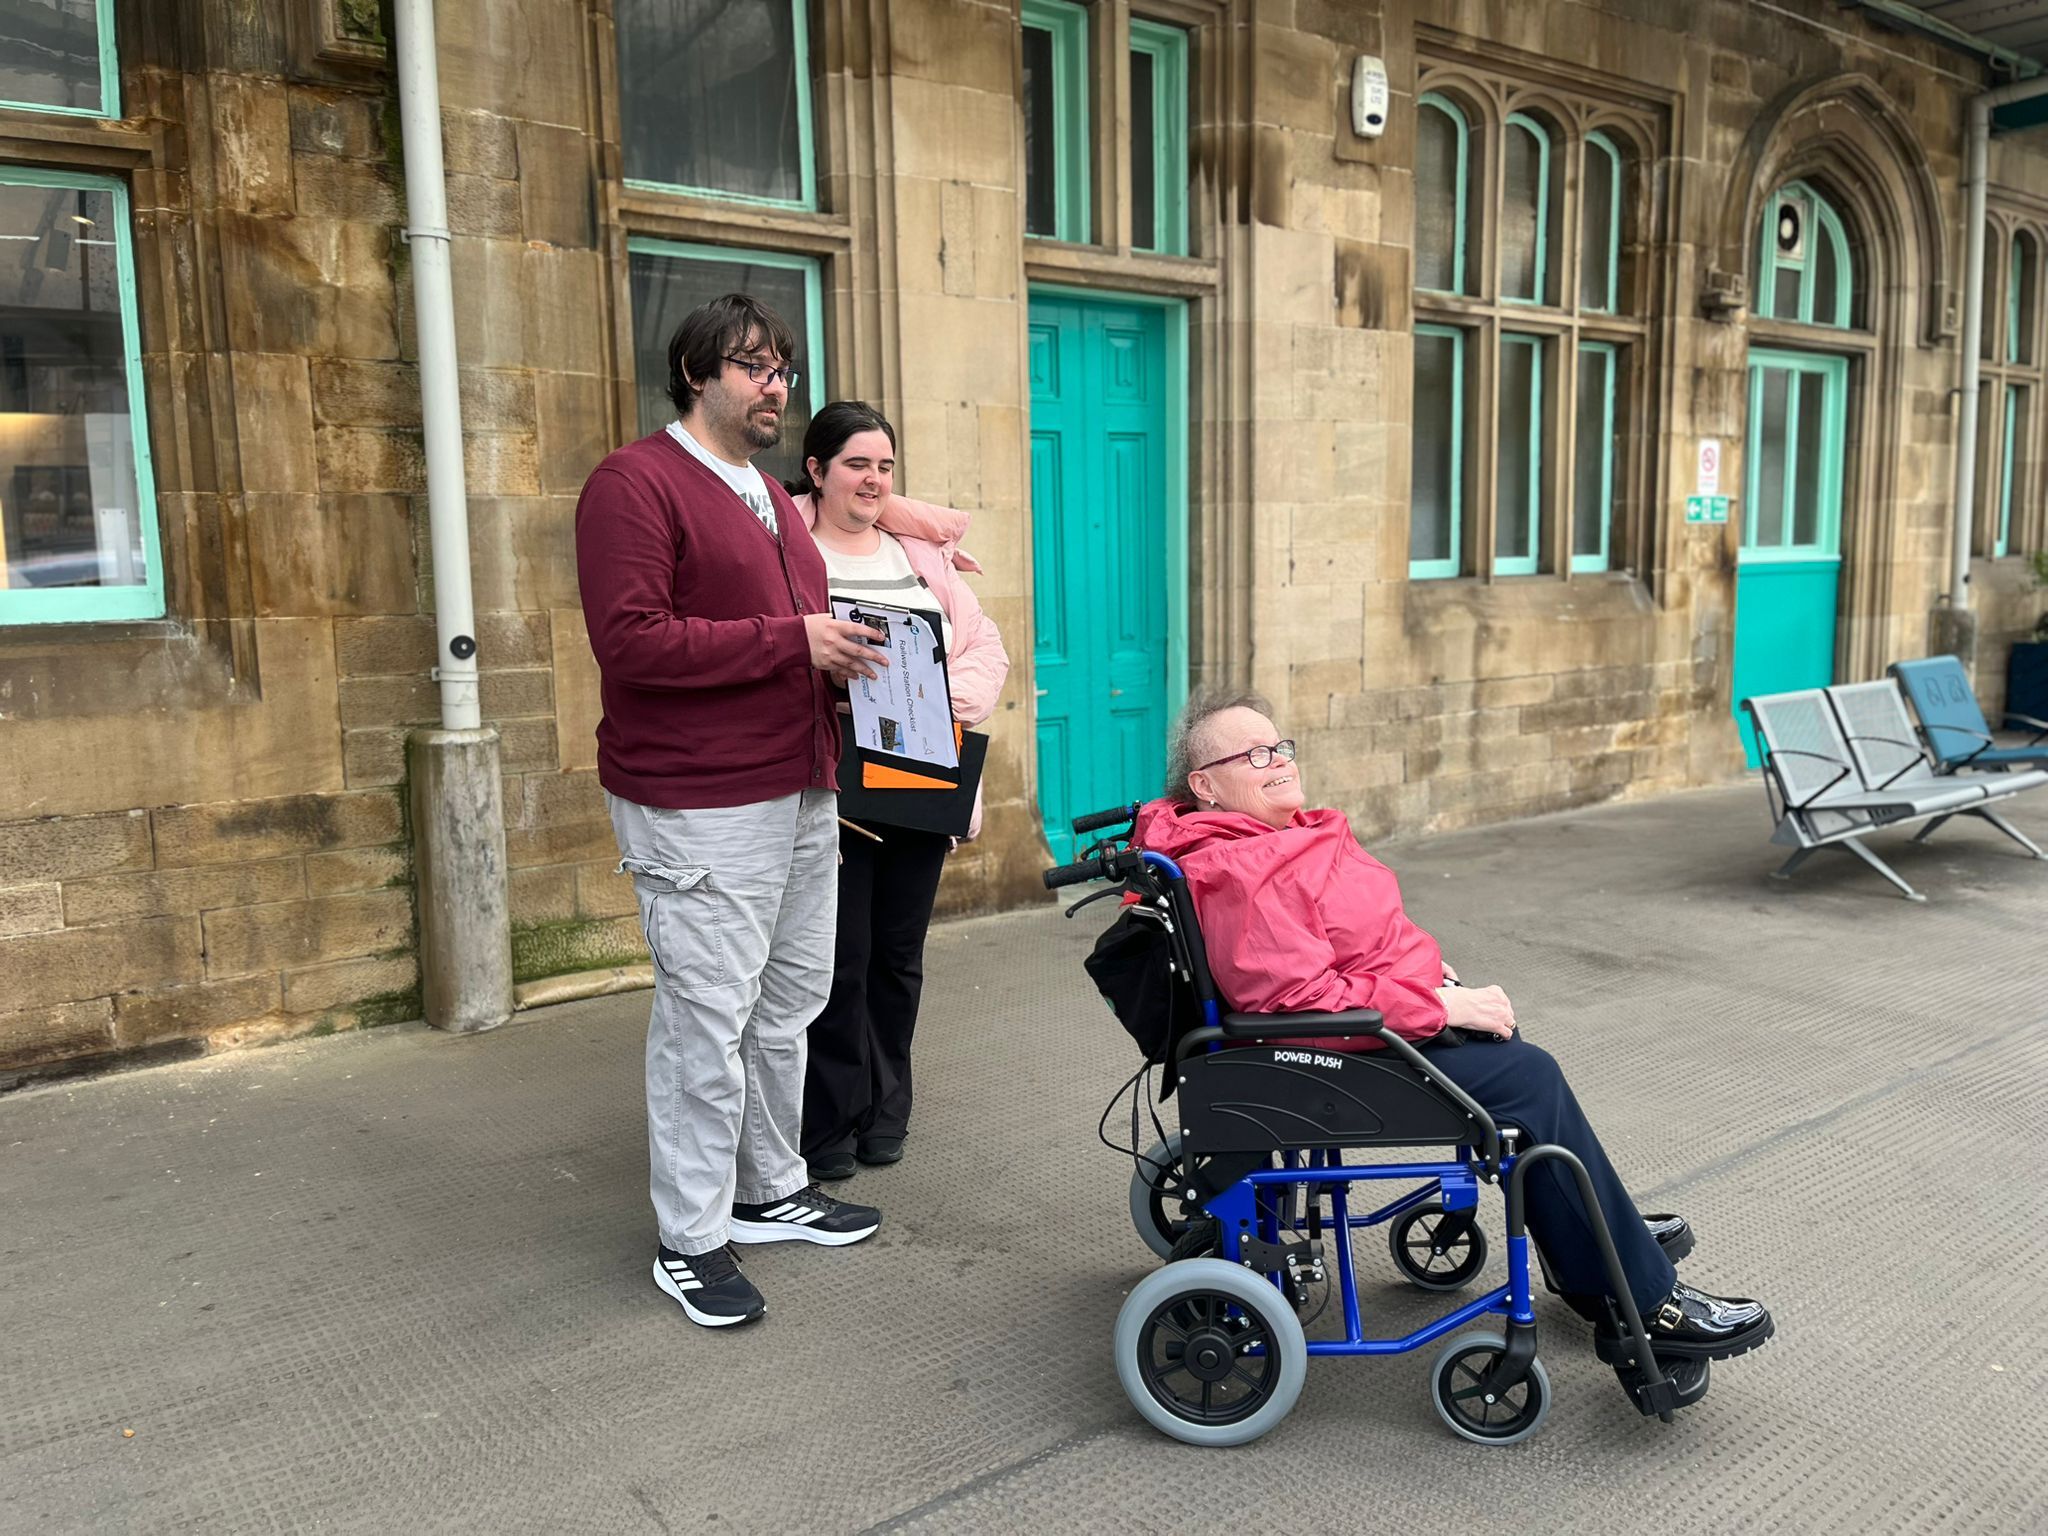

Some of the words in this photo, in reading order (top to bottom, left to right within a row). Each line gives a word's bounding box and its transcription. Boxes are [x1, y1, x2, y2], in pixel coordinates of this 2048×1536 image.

[899, 639, 907, 670] Railway
[903, 671, 911, 698] Station
[906, 698, 916, 733] Checklist
[1274, 1051, 1312, 1064] POWER
[1314, 1055, 1343, 1070] PUSH
